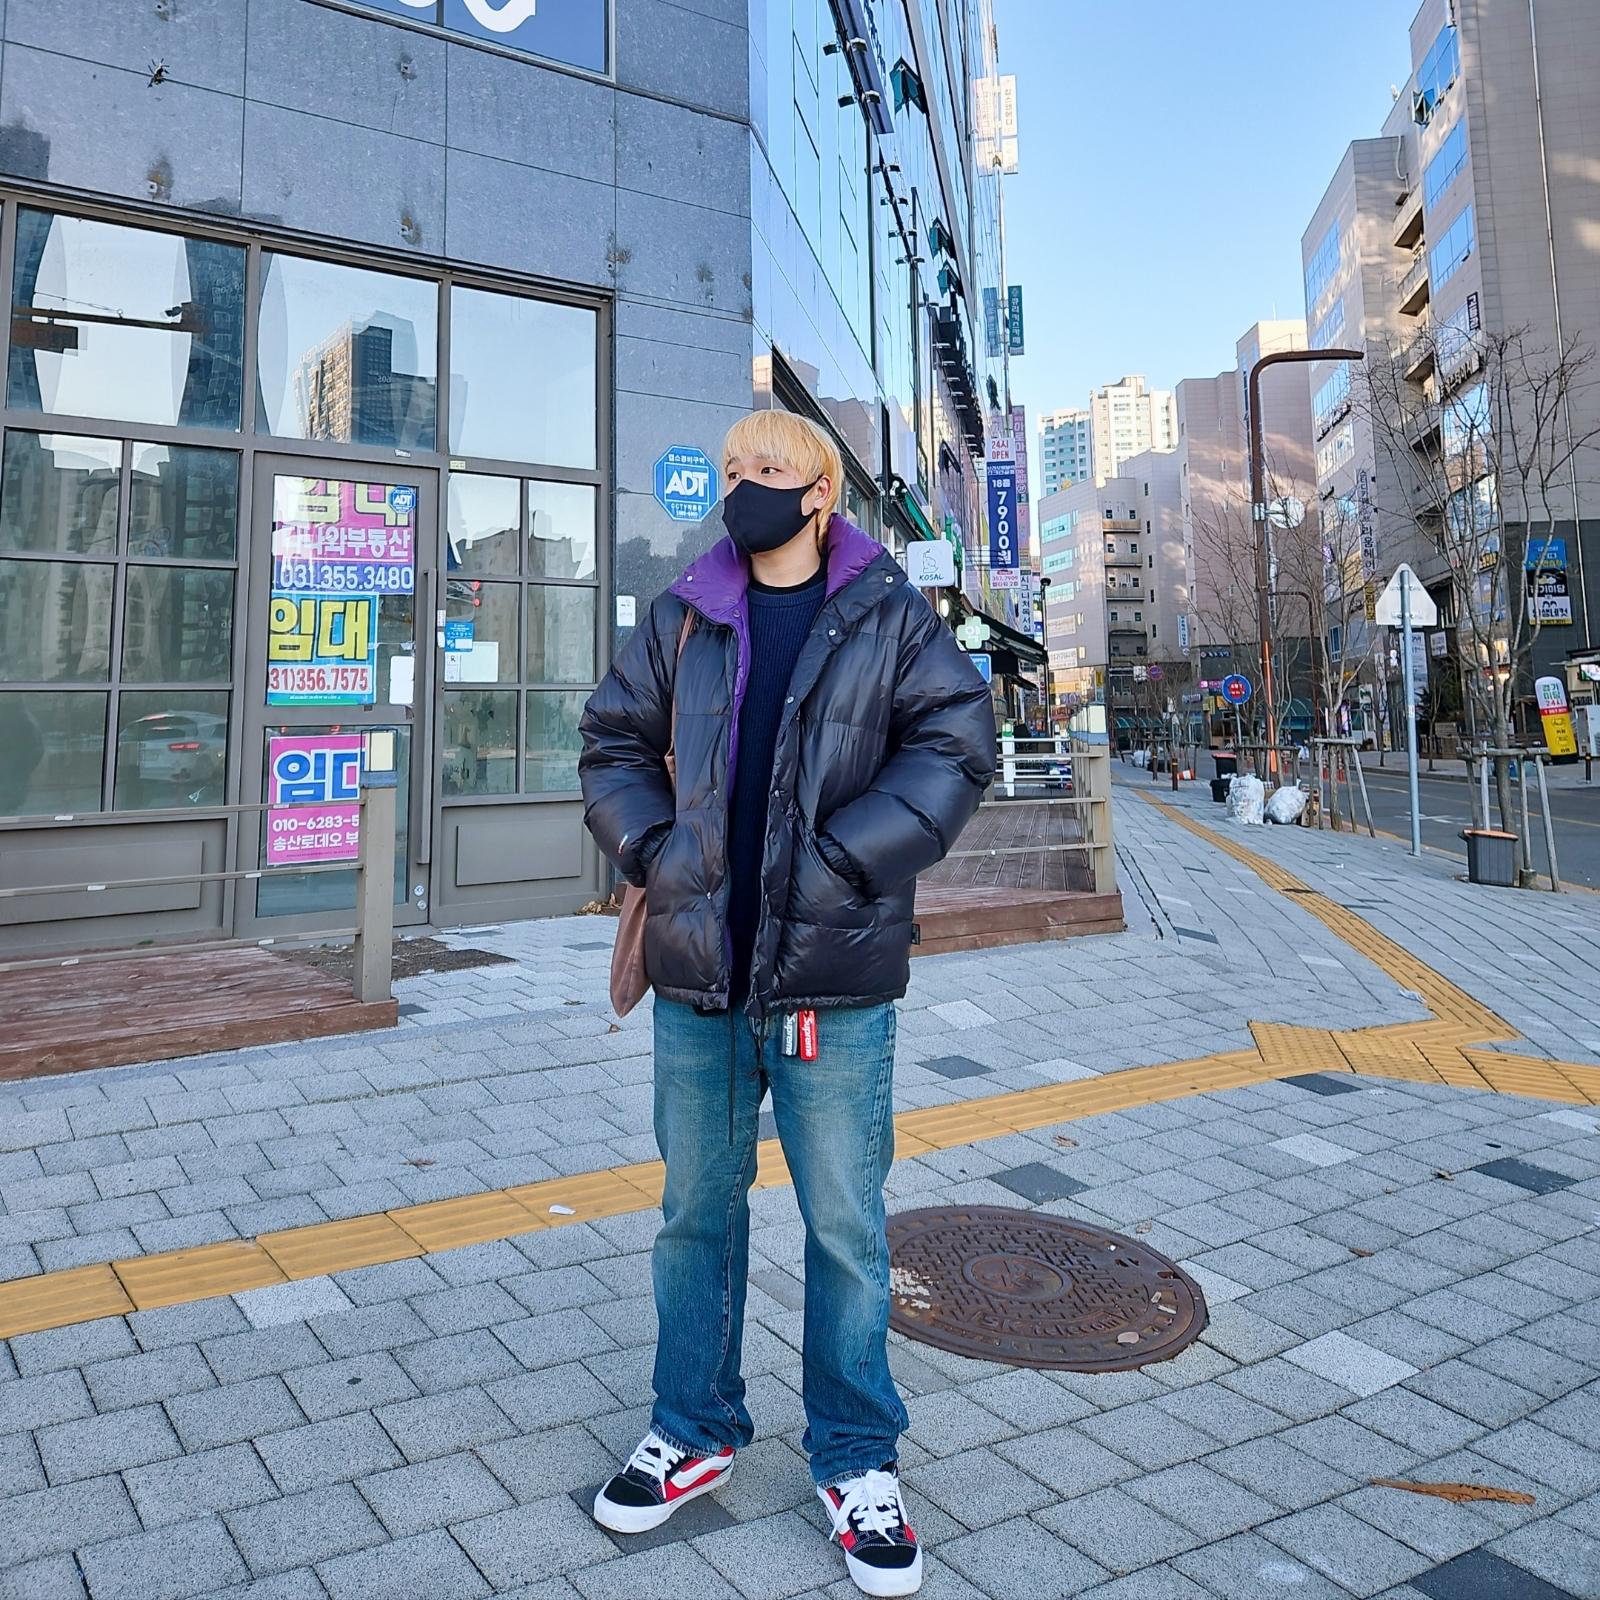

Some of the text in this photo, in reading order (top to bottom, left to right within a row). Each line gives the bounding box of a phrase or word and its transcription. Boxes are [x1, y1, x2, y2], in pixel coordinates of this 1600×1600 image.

[991, 450, 1010, 460] OPEN
[665, 469, 709, 498] ADT
[393, 494, 413, 506] ADT
[918, 573, 944, 582] KOSAL
[268, 598, 370, 662] 임대
[964, 625, 981, 643] 약
[269, 667, 369, 693] 31)356.7575
[272, 832, 343, 853] 송산로데오
[784, 1014, 796, 1056] Supreme
[801, 1014, 813, 1058] Supreme
[1030, 1314, 1123, 1338] telecom
